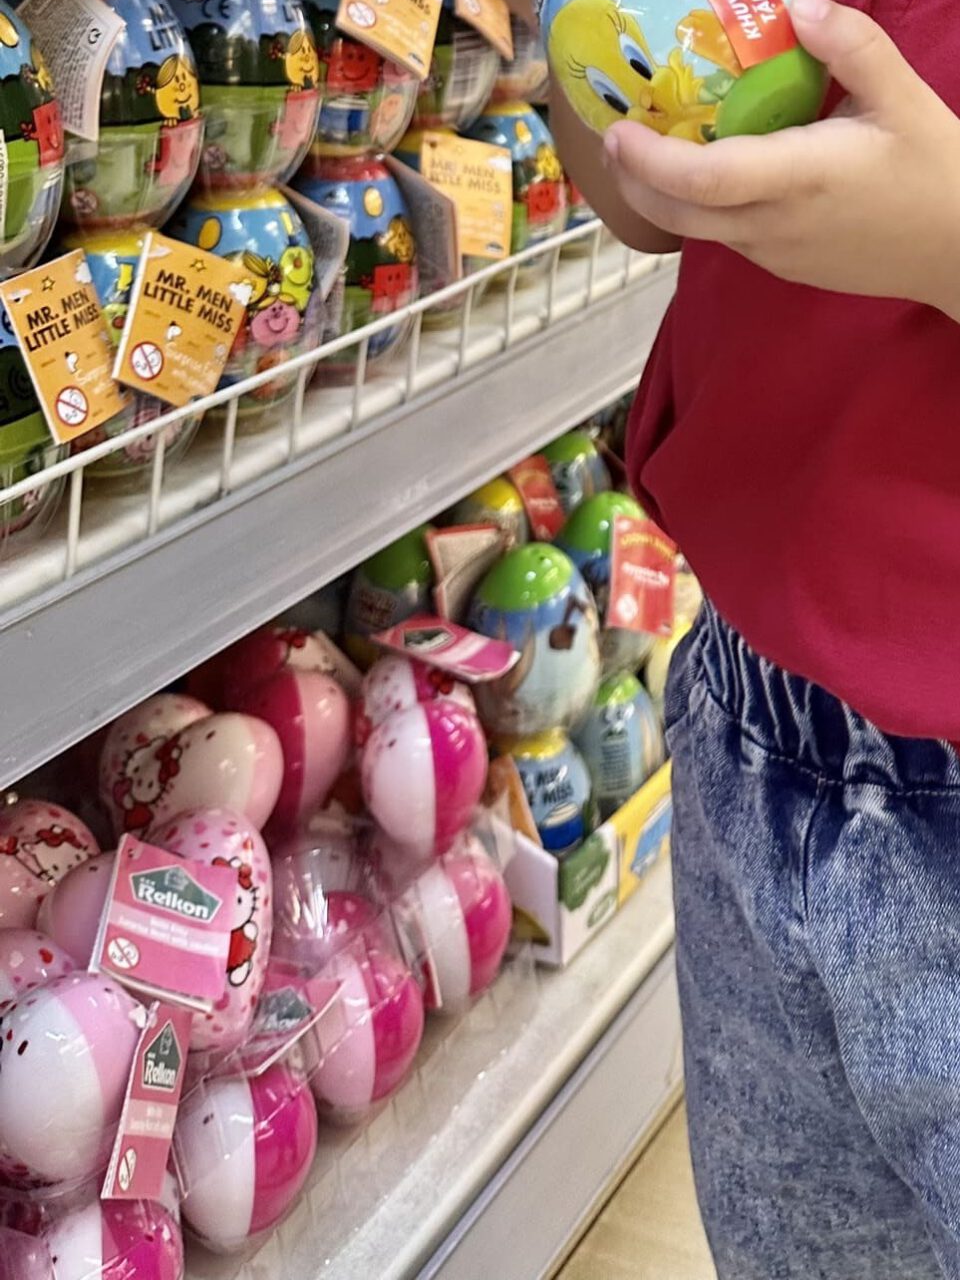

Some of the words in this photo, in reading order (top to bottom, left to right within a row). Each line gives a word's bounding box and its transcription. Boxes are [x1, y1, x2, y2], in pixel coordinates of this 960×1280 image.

[26, 305, 60, 330] MR.
[61, 287, 91, 316] MEN
[143, 282, 194, 313] LITTLE
[197, 303, 235, 335] MISS
[156, 269, 190, 294] MR.
[196, 285, 233, 313] MEN
[24, 322, 73, 353] LITTLE
[74, 302, 101, 331] MISS
[137, 882, 210, 919] Relkon
[143, 1059, 176, 1087] Relkon
